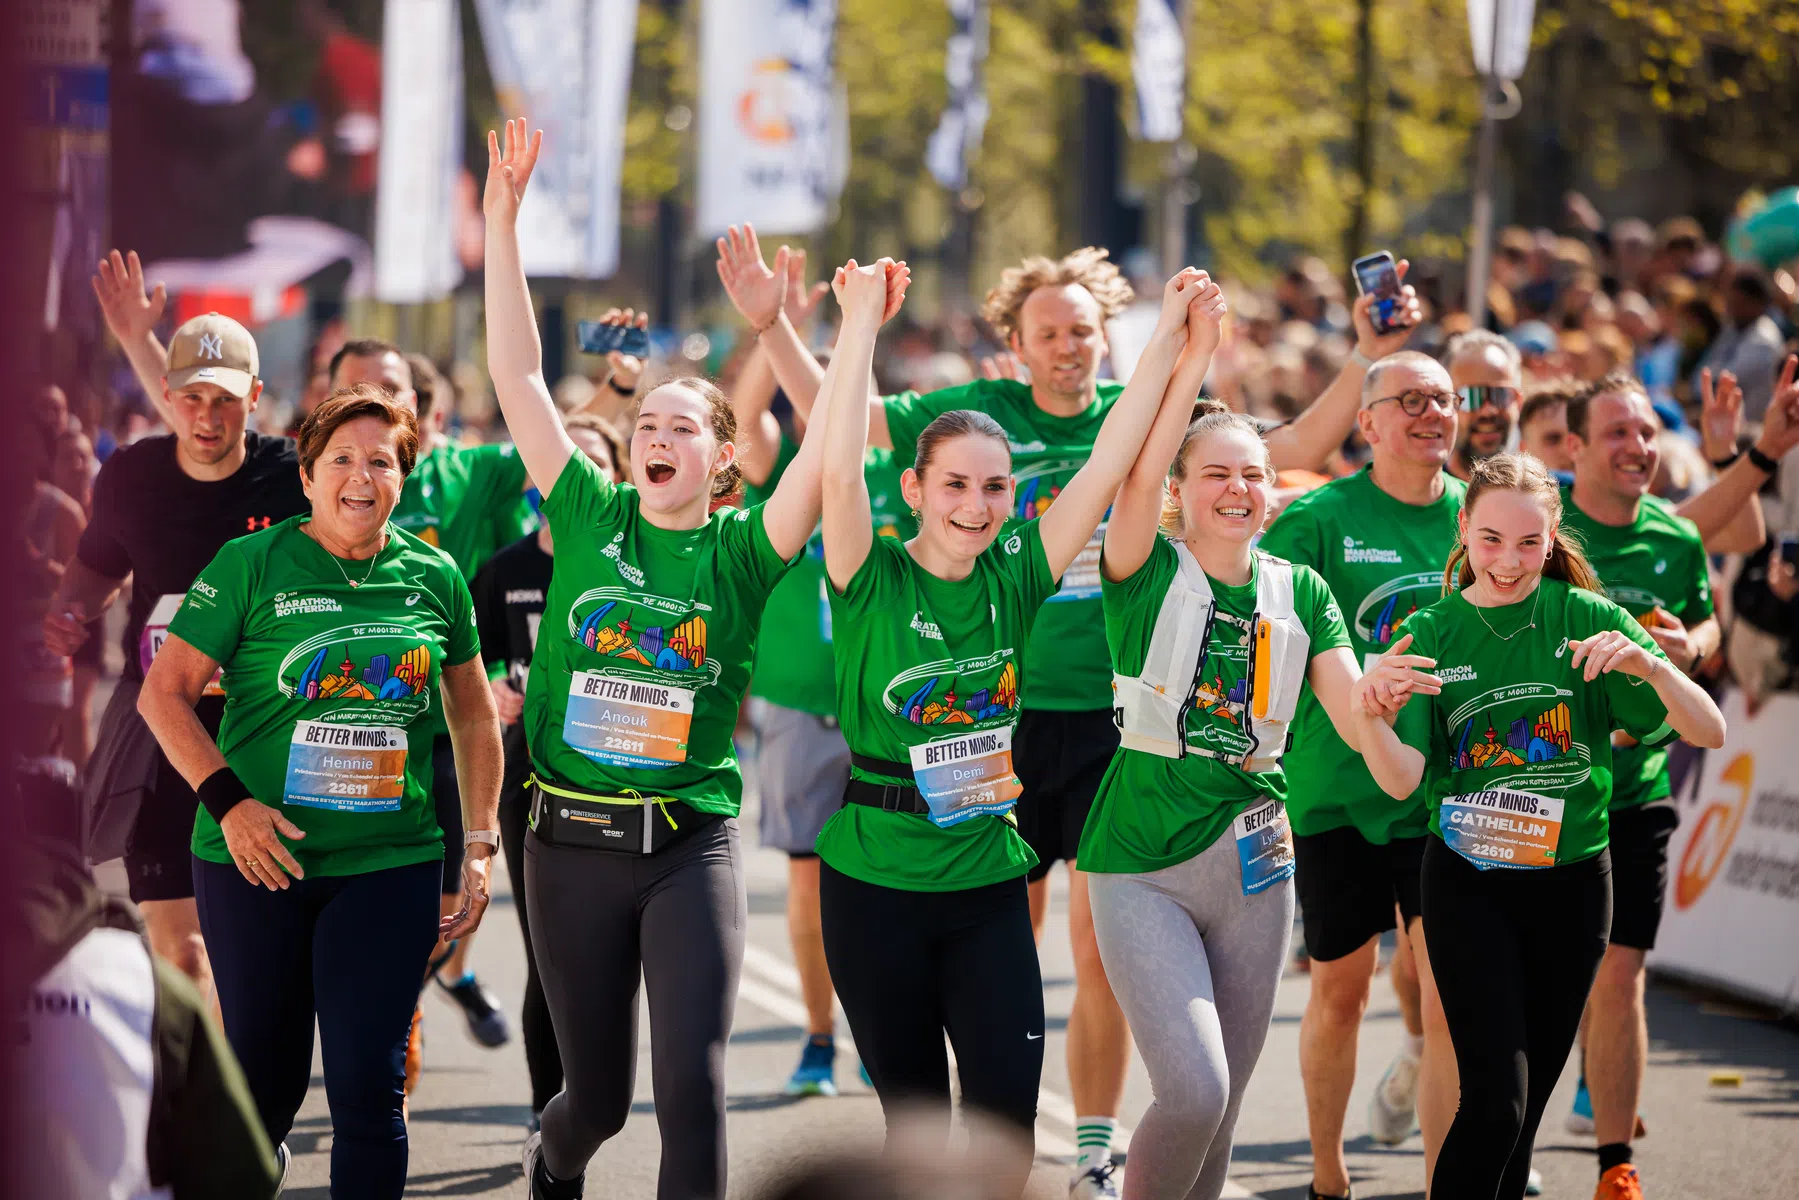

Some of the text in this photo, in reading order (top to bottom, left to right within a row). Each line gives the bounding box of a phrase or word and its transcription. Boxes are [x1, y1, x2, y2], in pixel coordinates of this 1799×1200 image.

[198, 333, 223, 360] NY
[1344, 548, 1397, 557] MARATHON
[1344, 555, 1402, 563] ROTTERDAM
[274, 597, 336, 611] MARATHON
[642, 597, 656, 606] DE
[275, 604, 342, 617] ROTTERDAM
[353, 627, 366, 635] DE
[583, 677, 629, 701] BETTER
[629, 684, 669, 707] MINDS
[1493, 686, 1543, 701] DE MOOISTE
[600, 709, 648, 727] Anouk
[571, 720, 610, 732] Printerservice
[305, 725, 387, 747] BETTER MINDS
[604, 736, 645, 753] 22611
[926, 734, 997, 765] BETTER MINDS
[323, 756, 373, 770] Hennie
[629, 757, 665, 767] MARATHON
[1537, 763, 1555, 771] EDITION
[953, 764, 984, 781] Demi
[328, 782, 368, 795] 22611
[1529, 777, 1565, 786] ROTTERDAM
[1499, 792, 1539, 814] MINDS
[570, 809, 611, 820] PRINTERSERVICE
[1244, 803, 1275, 833] BETTER
[1450, 810, 1547, 837] CATHELIJN
[1471, 843, 1514, 860] 22610
[1526, 841, 1550, 850] Partners
[1247, 876, 1271, 890] BUSINESS
